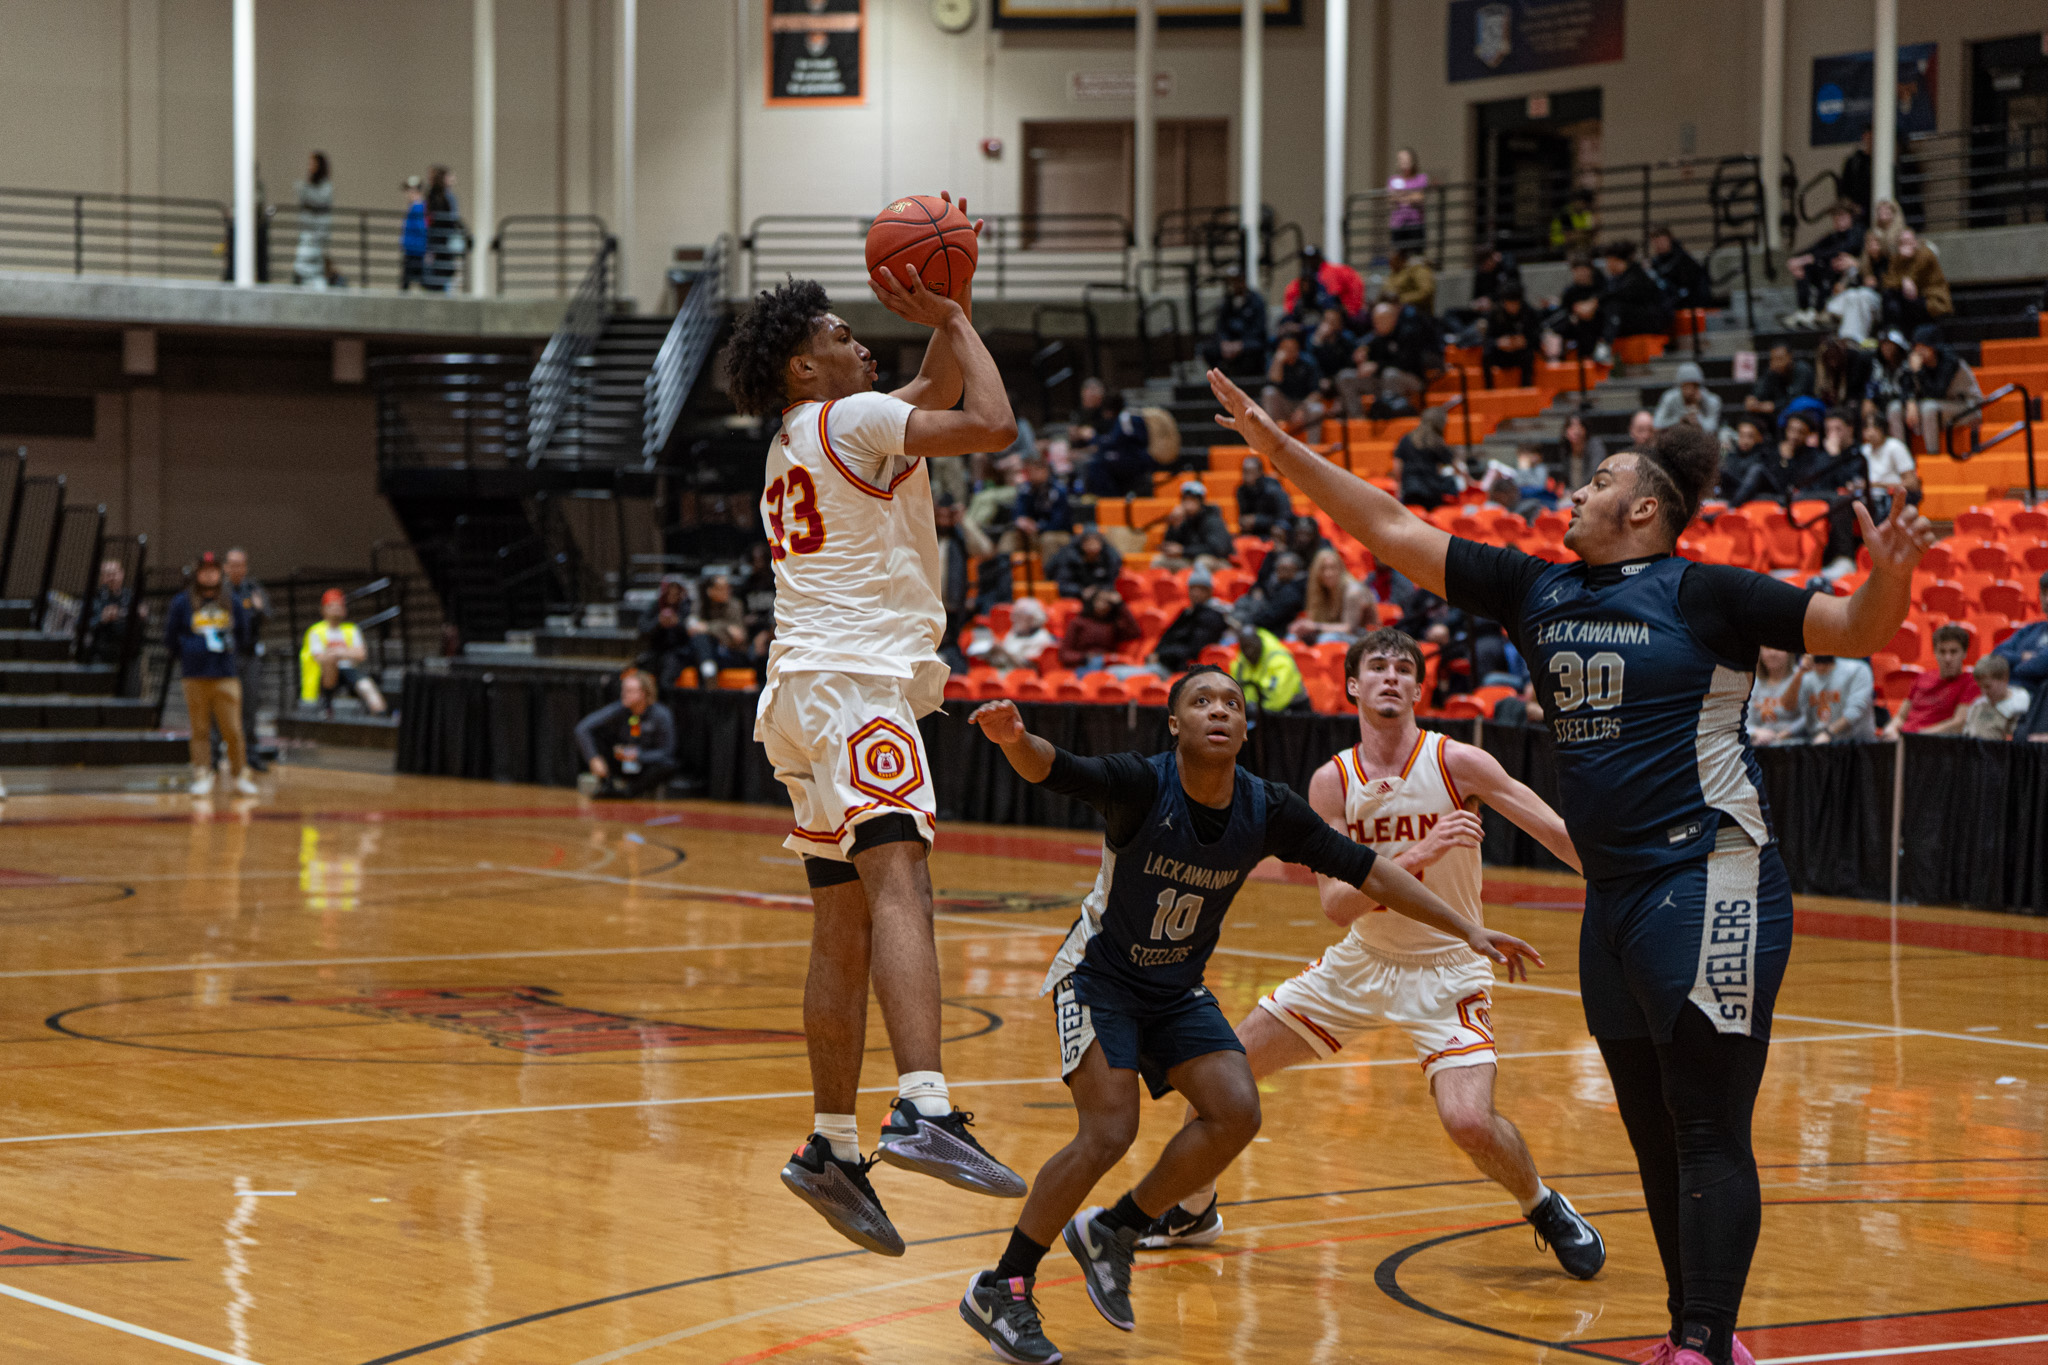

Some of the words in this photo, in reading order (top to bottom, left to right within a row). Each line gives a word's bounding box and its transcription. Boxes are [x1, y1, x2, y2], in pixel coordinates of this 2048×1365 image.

[1537, 620, 1650, 646] LACKAWANNA
[1549, 651, 1625, 711] 30
[1554, 716, 1623, 743] STEELERS
[1688, 825, 1699, 835] XL
[1143, 851, 1239, 890] LACKAWANNA
[1150, 887, 1204, 941] 10
[1129, 943, 1193, 967] STEELERS
[1706, 900, 1751, 1021] STEELERS
